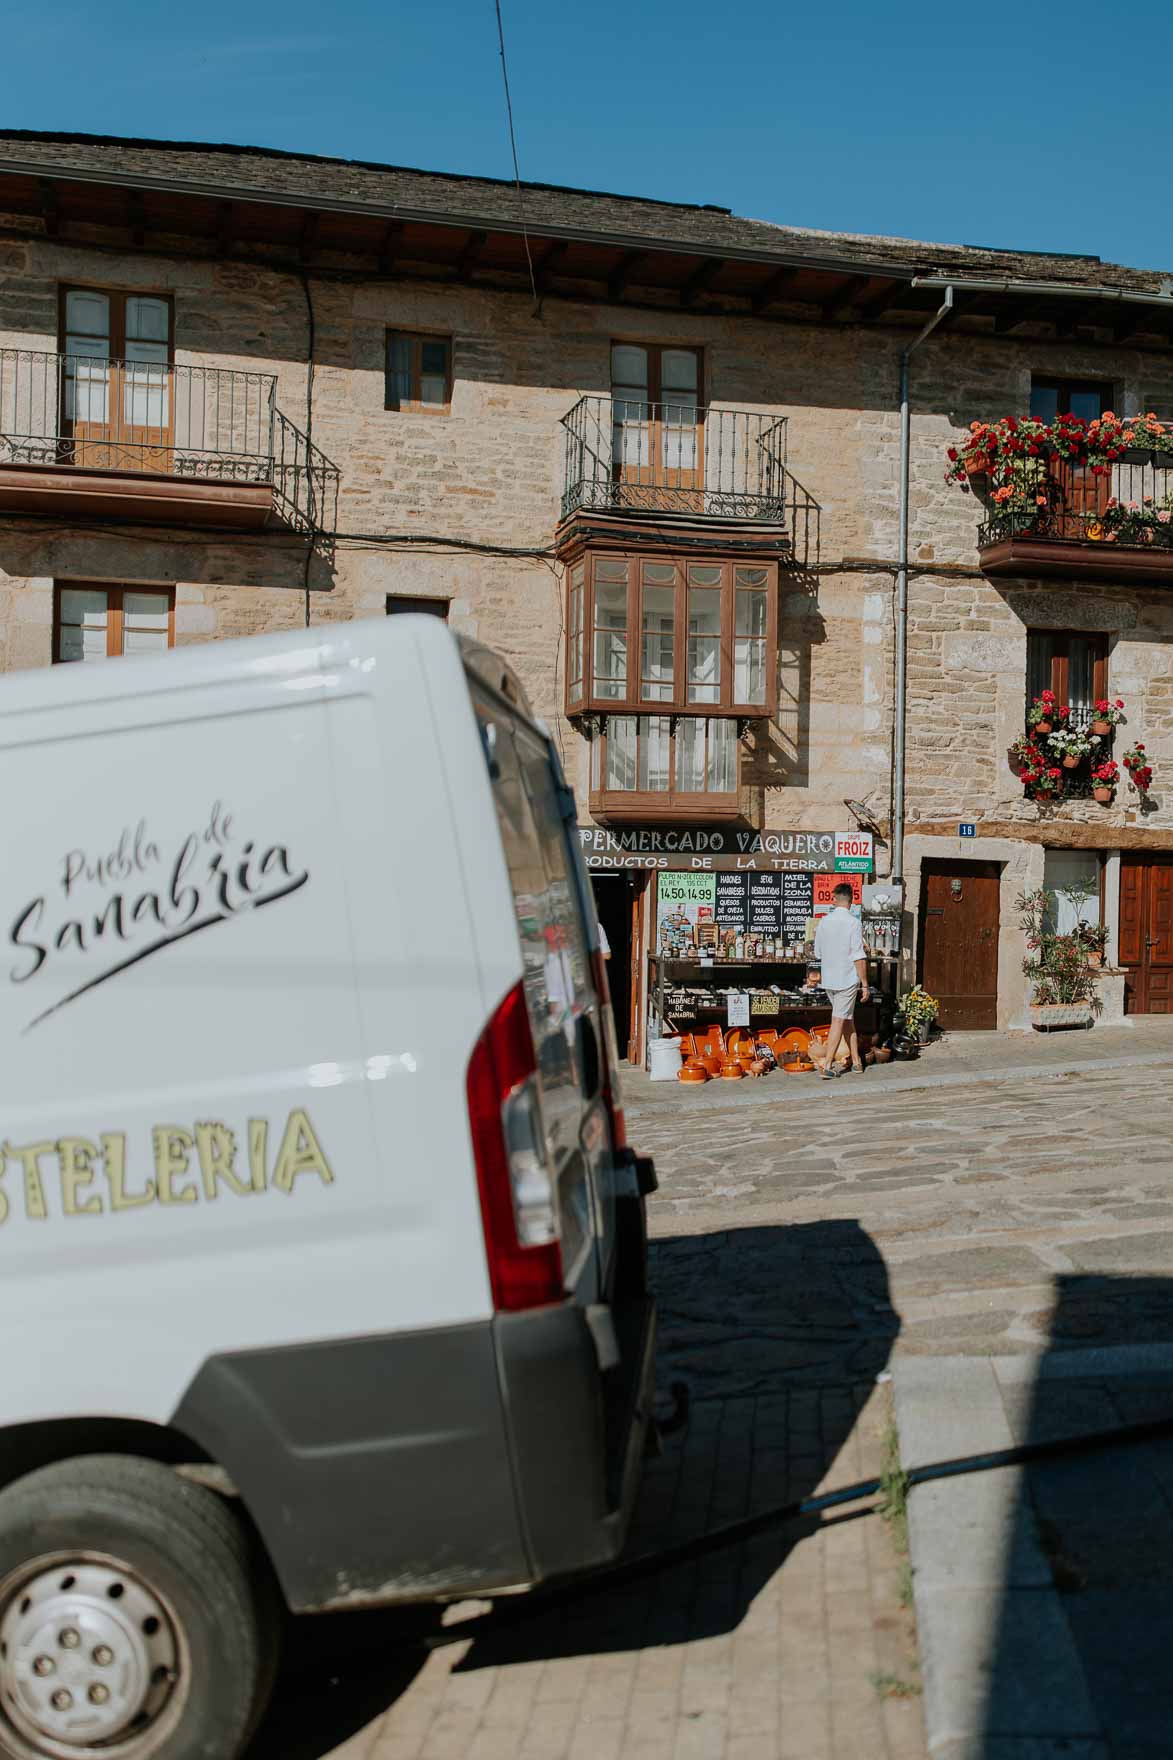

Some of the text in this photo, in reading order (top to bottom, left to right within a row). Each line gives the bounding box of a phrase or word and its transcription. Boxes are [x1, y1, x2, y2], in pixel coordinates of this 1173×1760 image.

[578, 829, 833, 854] PERMERCADO VAQUERO
[837, 841, 869, 856] FROIZ
[61, 800, 233, 899] Puebla de
[584, 856, 828, 870] RODUCTOS DE LA TIERRA
[720, 875, 742, 884] HABONES
[760, 875, 773, 884] SETAS
[10, 832, 291, 983] Sanabria
[668, 996, 695, 1005] HABONES
